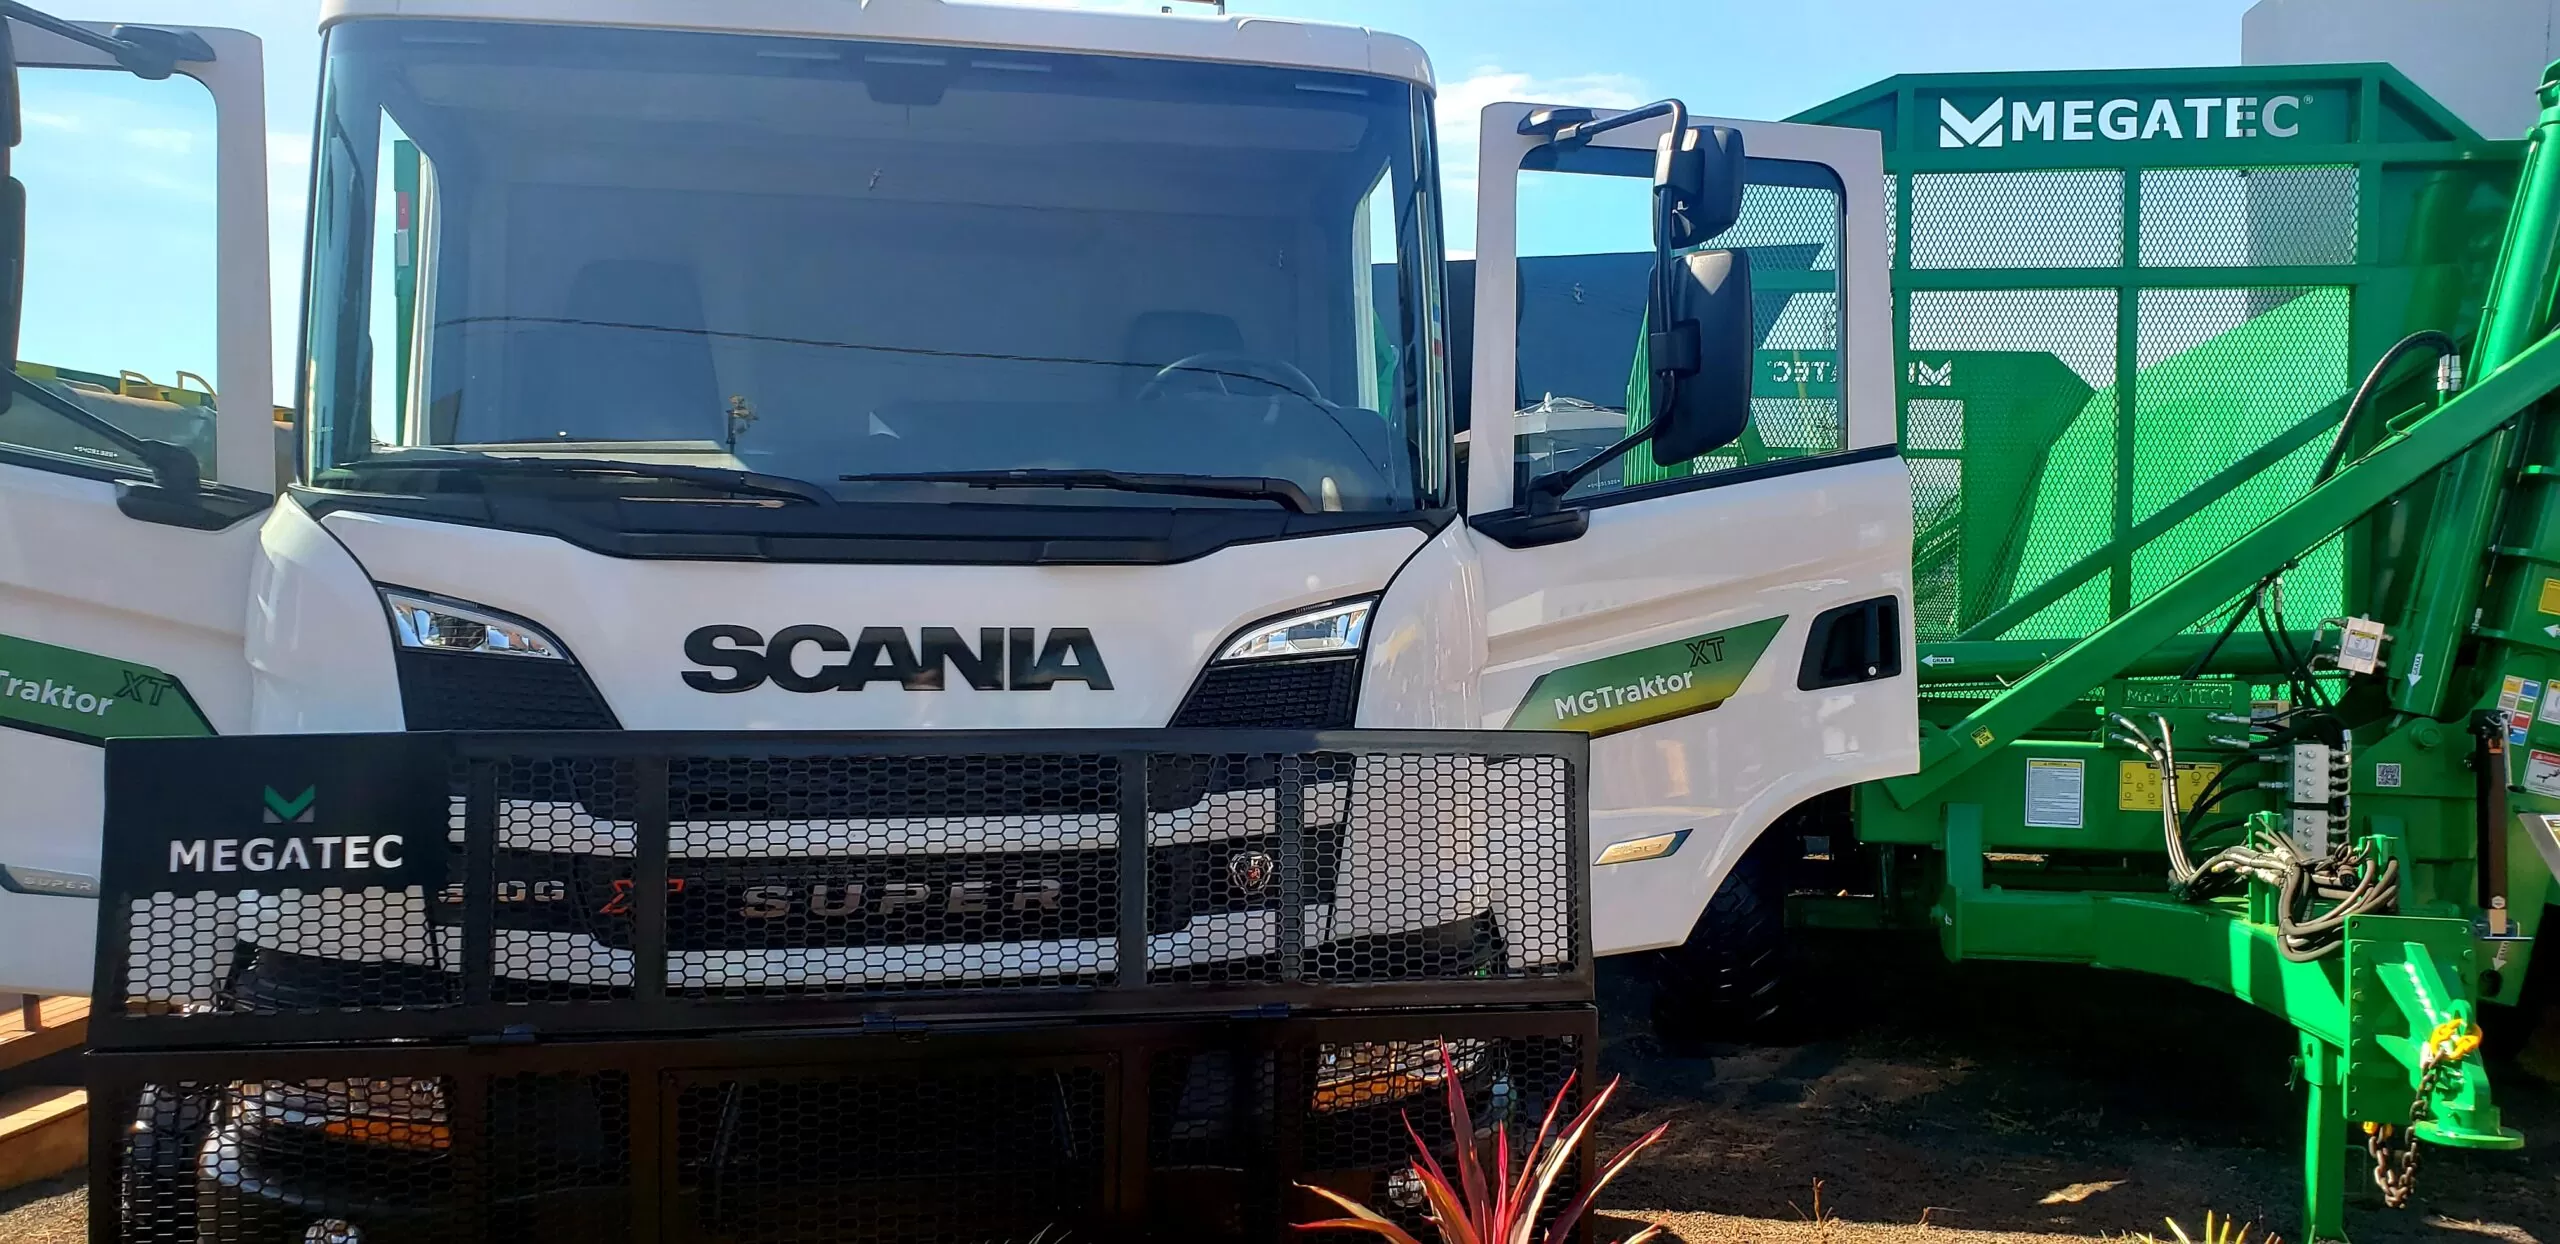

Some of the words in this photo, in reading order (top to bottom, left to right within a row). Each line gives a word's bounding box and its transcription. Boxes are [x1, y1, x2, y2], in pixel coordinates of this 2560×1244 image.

[681, 624, 1115, 693] SCANIA
[1554, 670, 1693, 720] MGTraktor
[1685, 636, 1725, 668] XT
[114, 668, 175, 706] XT
[169, 834, 404, 873] MEGATEC
[23, 876, 93, 892] SUPER
[739, 879, 1061, 919] SUPER
